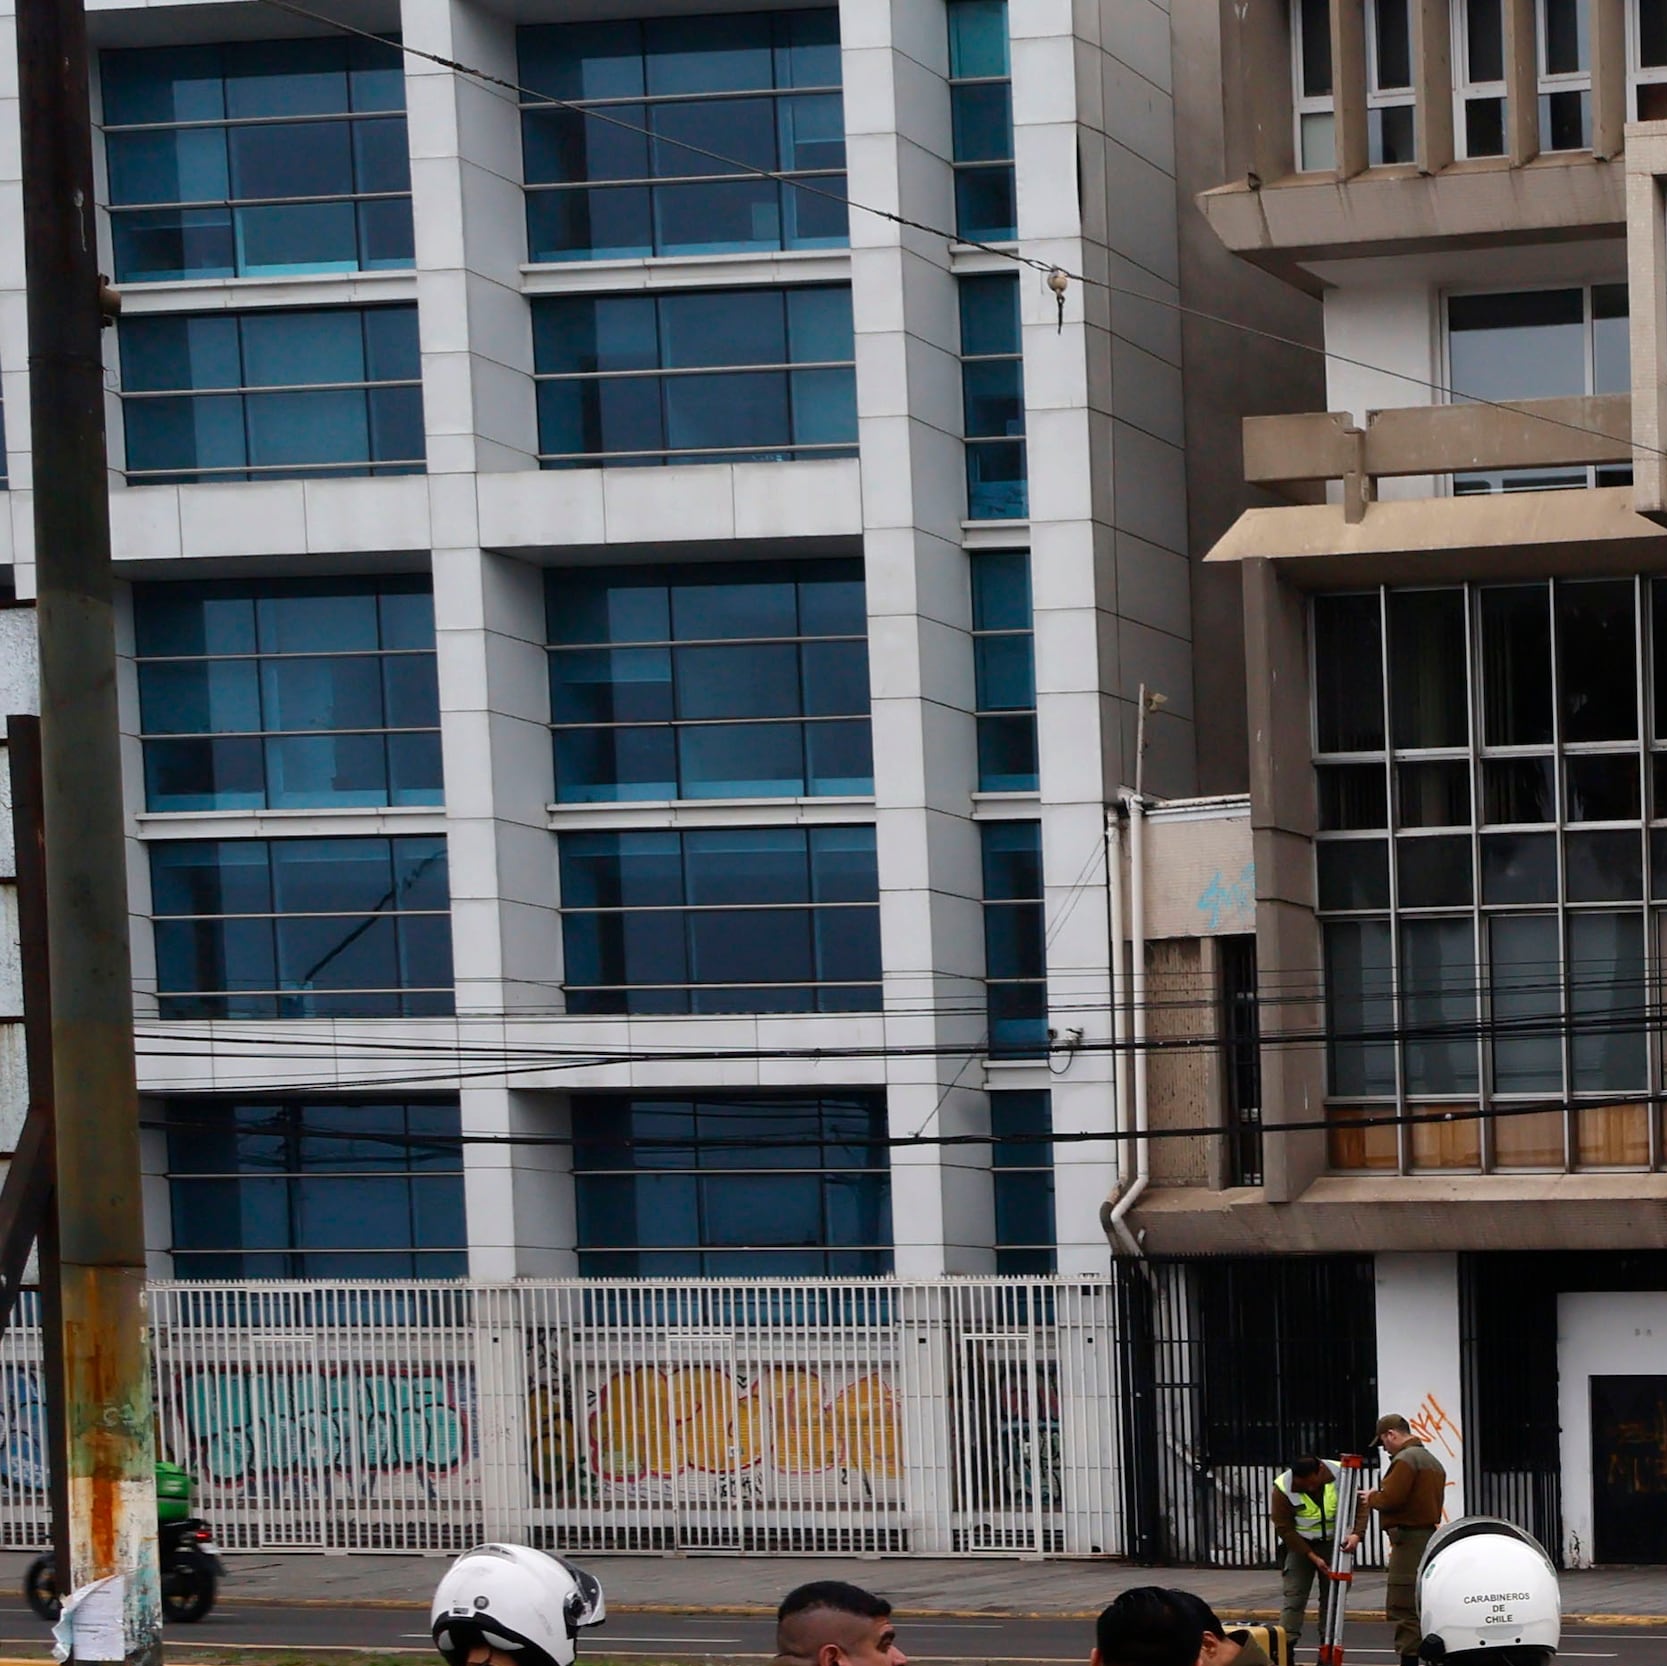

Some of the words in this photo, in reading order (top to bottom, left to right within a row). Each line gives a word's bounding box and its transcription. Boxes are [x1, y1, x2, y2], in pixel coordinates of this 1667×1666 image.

[1463, 1592, 1530, 1605] CARABINEROS
[1492, 1604, 1505, 1612] DE
[1485, 1614, 1513, 1624] CHILE
